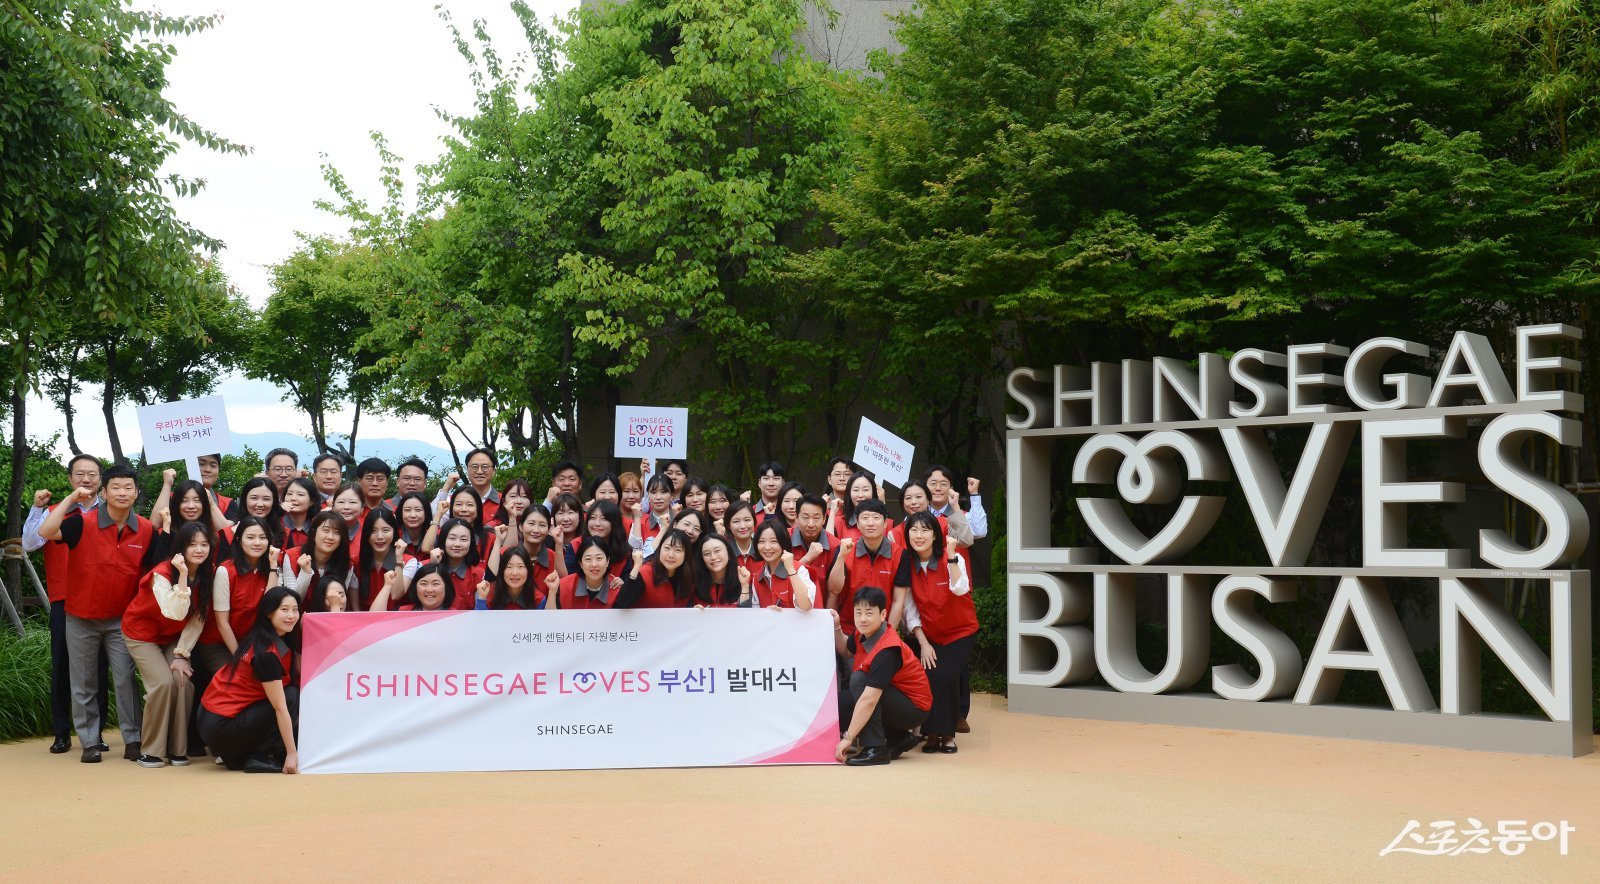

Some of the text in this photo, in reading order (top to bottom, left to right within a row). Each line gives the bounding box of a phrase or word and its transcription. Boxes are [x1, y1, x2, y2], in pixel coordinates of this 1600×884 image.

[1006, 324, 1570, 430] SHINSEGAE
[155, 414, 213, 431] 우리가 전하는
[629, 416, 674, 424] SHINSEGAE
[628, 424, 674, 437] LOVES
[628, 436, 674, 448] BUSAN
[863, 445, 870, 454] 더
[1006, 411, 1574, 569] LOVES
[511, 631, 638, 643] 신세계 센텀시티 자원봉사단
[1008, 571, 1572, 721] BUSAN
[346, 667, 797, 700] [SHINSEGAE LOVES 부산] 발대식
[537, 724, 614, 735] SHINSEGAE
